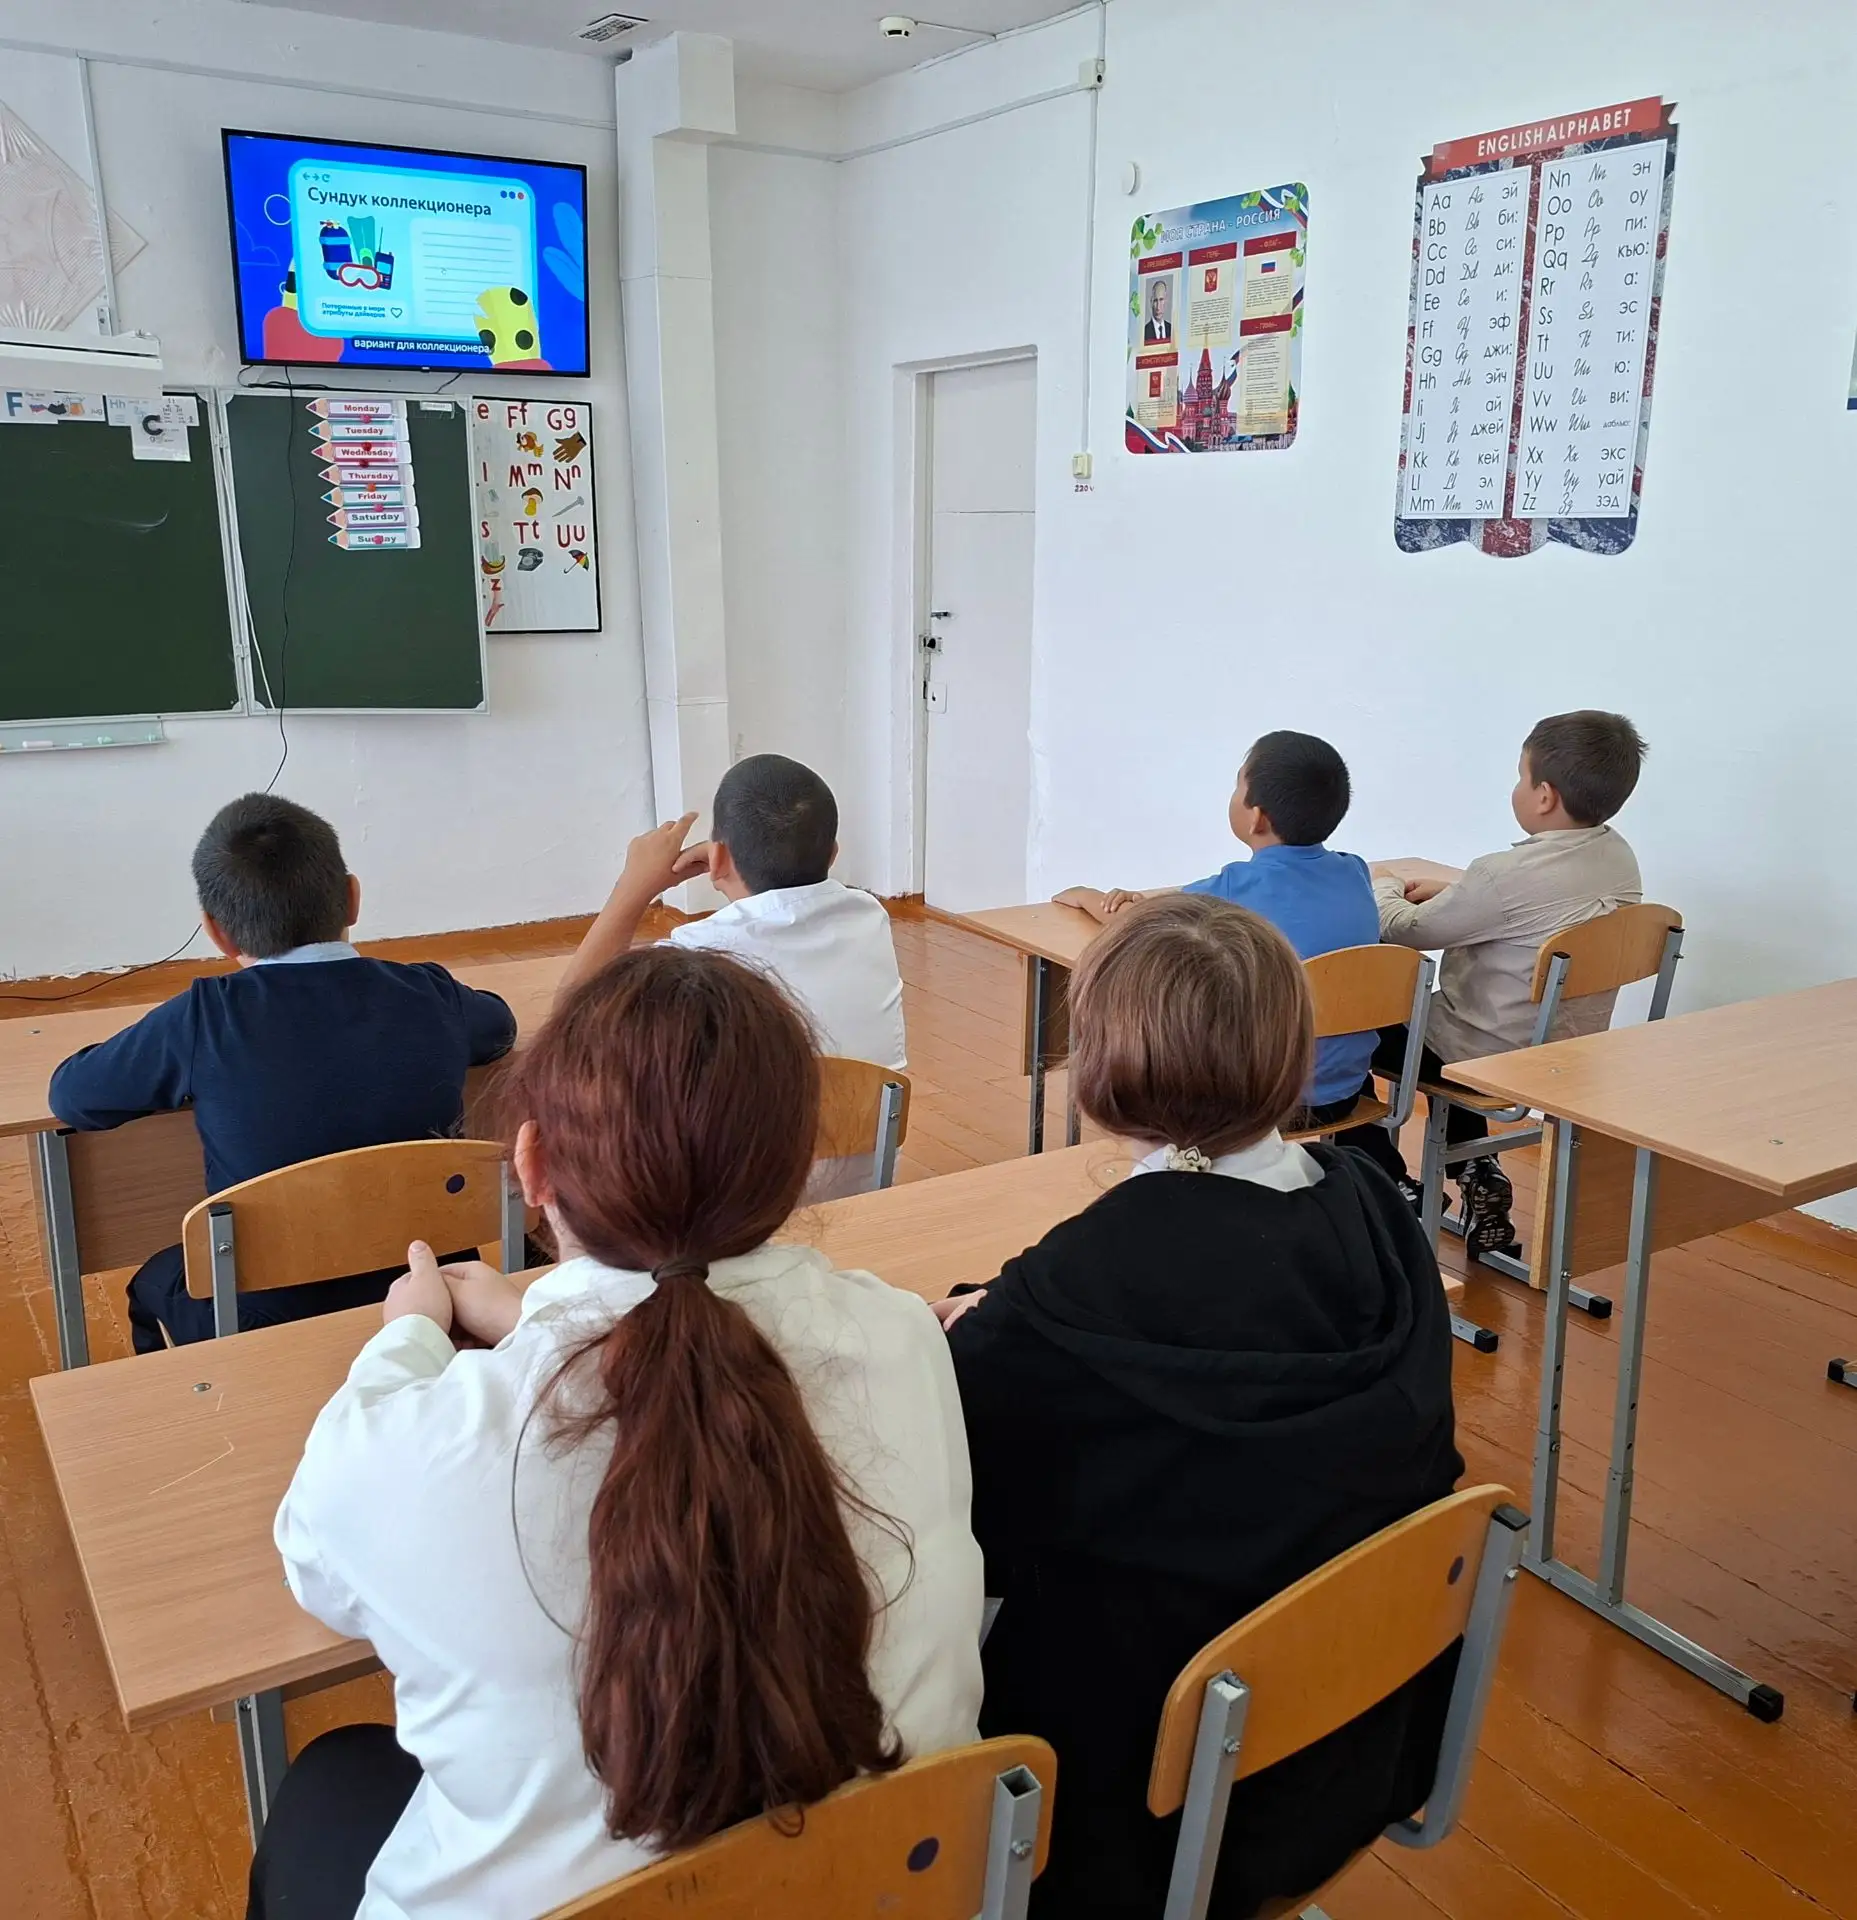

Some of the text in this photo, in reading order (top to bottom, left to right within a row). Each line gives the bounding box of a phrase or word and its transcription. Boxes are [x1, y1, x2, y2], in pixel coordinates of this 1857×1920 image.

[1478, 108, 1632, 157] ENGLISH ALPHABET
[1550, 161, 1651, 190] Nn Nn эн
[307, 186, 492, 217] Сундук коллекционера
[1431, 182, 1518, 211] Aa Aa эй
[1548, 188, 1648, 215] Oo Oo оу
[1161, 228, 1184, 243] МОЯ
[1186, 219, 1226, 239] СТРАНА
[1236, 208, 1281, 228] РОССИЯ
[1429, 209, 1518, 236] Bb Bb би:
[1545, 216, 1647, 246] Pp Pp пи:
[1427, 237, 1516, 261] Cc Cc си:
[1543, 249, 1568, 270] Qq
[1426, 261, 1513, 286] Dd Dd ди:
[1540, 272, 1638, 296] Rr Rr а:
[1424, 288, 1507, 311] Ee Ee и:
[1539, 301, 1638, 325] Ss Ss эс
[1422, 313, 1510, 340] Ff Ff эф
[354, 338, 492, 354] вариант для коллекционера.
[1538, 329, 1635, 352] Tt Tt ти:
[1422, 342, 1512, 367] Gg Gg джи:
[1419, 369, 1506, 390] Hh Hh эйч
[1534, 358, 1630, 380] Uu Uu ю:
[6, 391, 23, 417] F
[109, 399, 126, 409] Hh
[344, 404, 380, 413] Monday
[1417, 396, 1501, 416] Ii Ii ай
[1533, 387, 1629, 407] Vv Vv ви:
[507, 402, 528, 429] Ff
[547, 407, 576, 430] Gg
[1530, 416, 1557, 433] Ww
[1568, 413, 1590, 432] Ww
[345, 427, 384, 436] Tuesday
[1416, 418, 1503, 444] Jj Jj джей
[341, 449, 393, 457] Wednesday
[1413, 449, 1499, 468] Kk Kk кей
[1526, 444, 1626, 464] Xx Xx экс
[348, 472, 393, 480] Thursday
[509, 462, 543, 487] Mm
[554, 464, 581, 490] Nn
[1411, 472, 1493, 491] Ll Ll эл
[1525, 469, 1624, 493] Yy Yy уай
[358, 493, 387, 501] Friday
[1410, 495, 1493, 512] Mm Mm эм
[1522, 493, 1536, 511] Zz
[1596, 496, 1619, 507] зэд
[352, 513, 400, 522] Saturday
[513, 519, 540, 544] Tt
[556, 523, 586, 548] Uu
